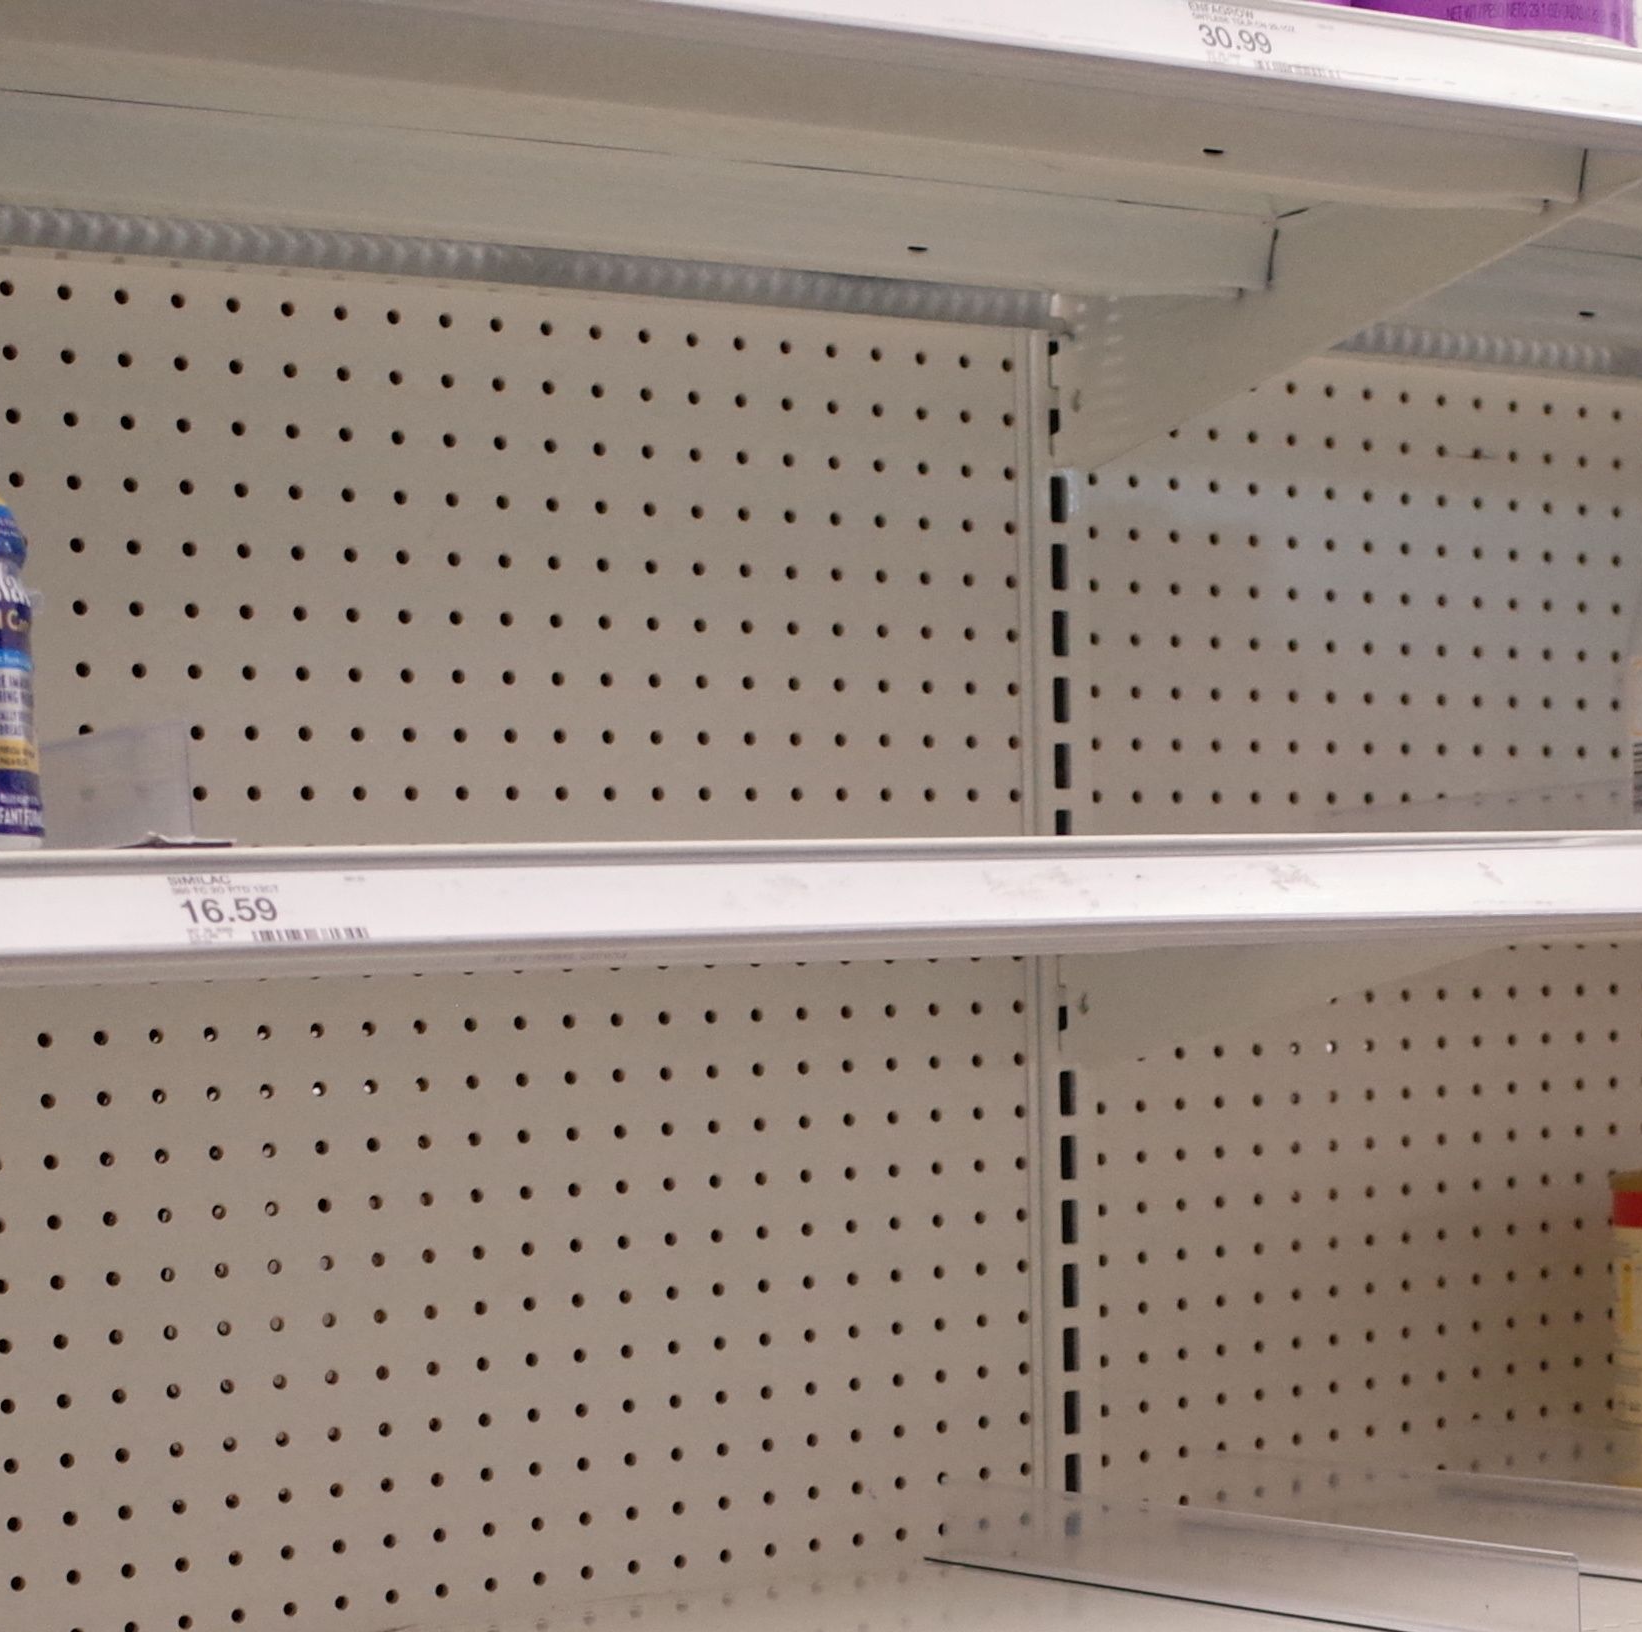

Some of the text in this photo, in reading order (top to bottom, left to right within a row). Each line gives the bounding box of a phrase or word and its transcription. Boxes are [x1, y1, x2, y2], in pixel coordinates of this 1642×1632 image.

[1198, 24, 1272, 55] 30.99
[167, 875, 232, 886] SIMILAC
[180, 898, 278, 924] 16.59
